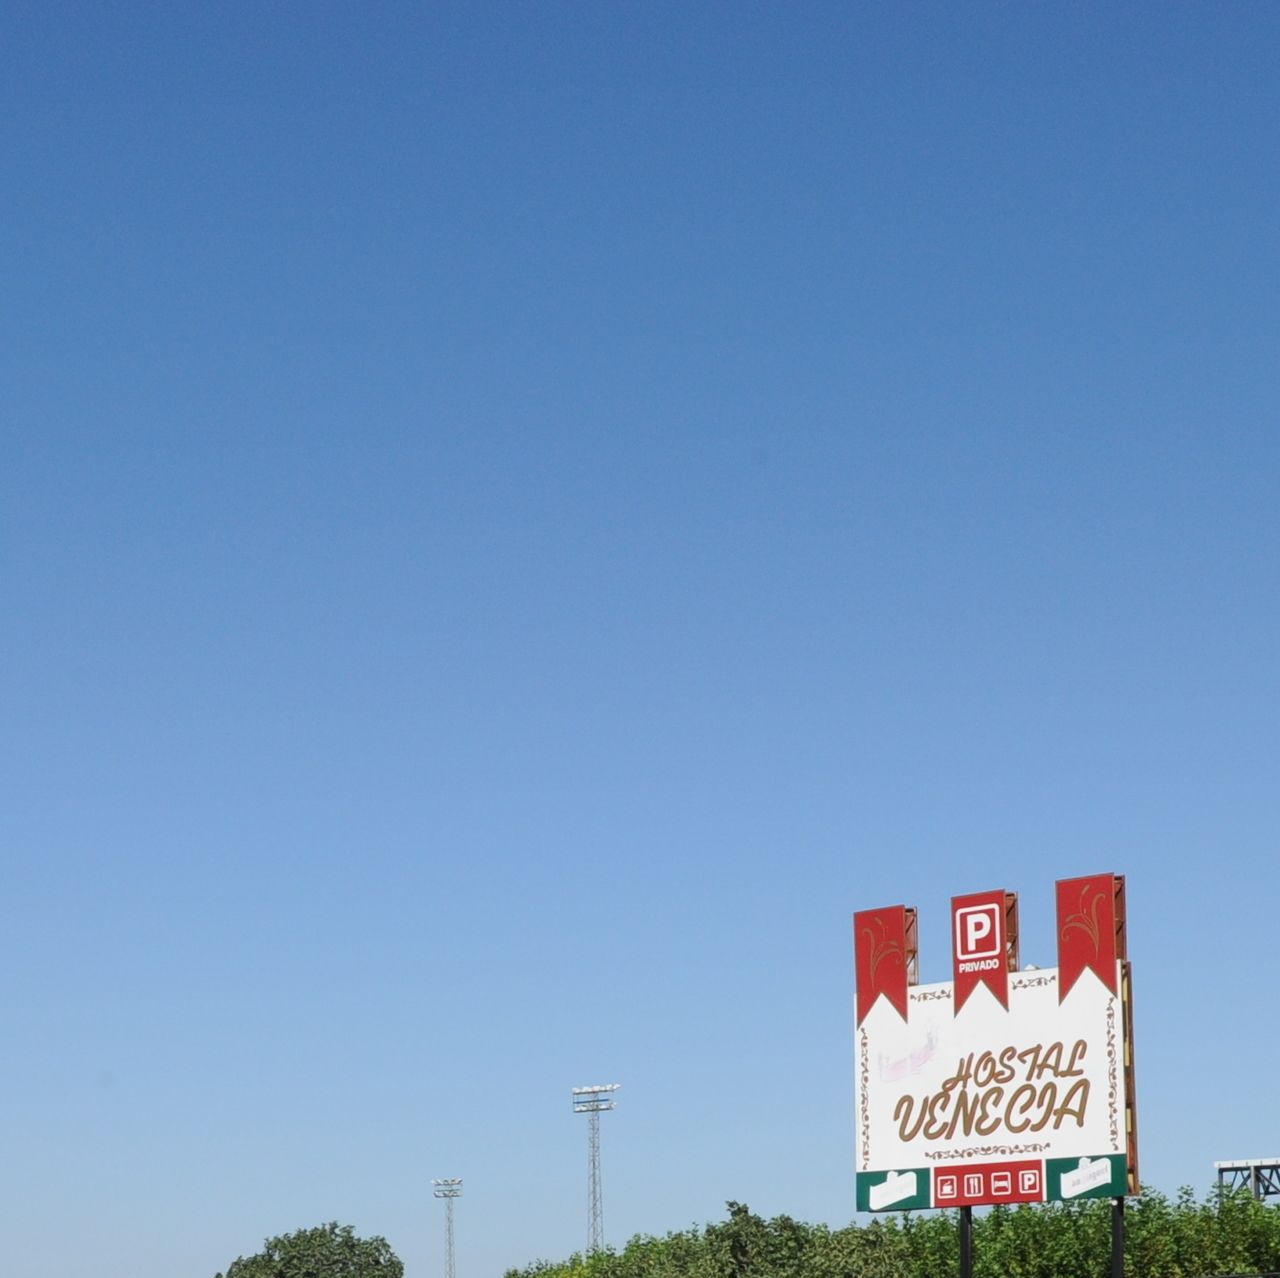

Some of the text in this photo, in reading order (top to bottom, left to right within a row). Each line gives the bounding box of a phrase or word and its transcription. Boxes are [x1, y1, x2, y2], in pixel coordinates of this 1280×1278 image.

[959, 958, 1000, 974] PRIVADO
[941, 1039, 1088, 1092] HOSTAL
[893, 1078, 1091, 1143] VENECIA
